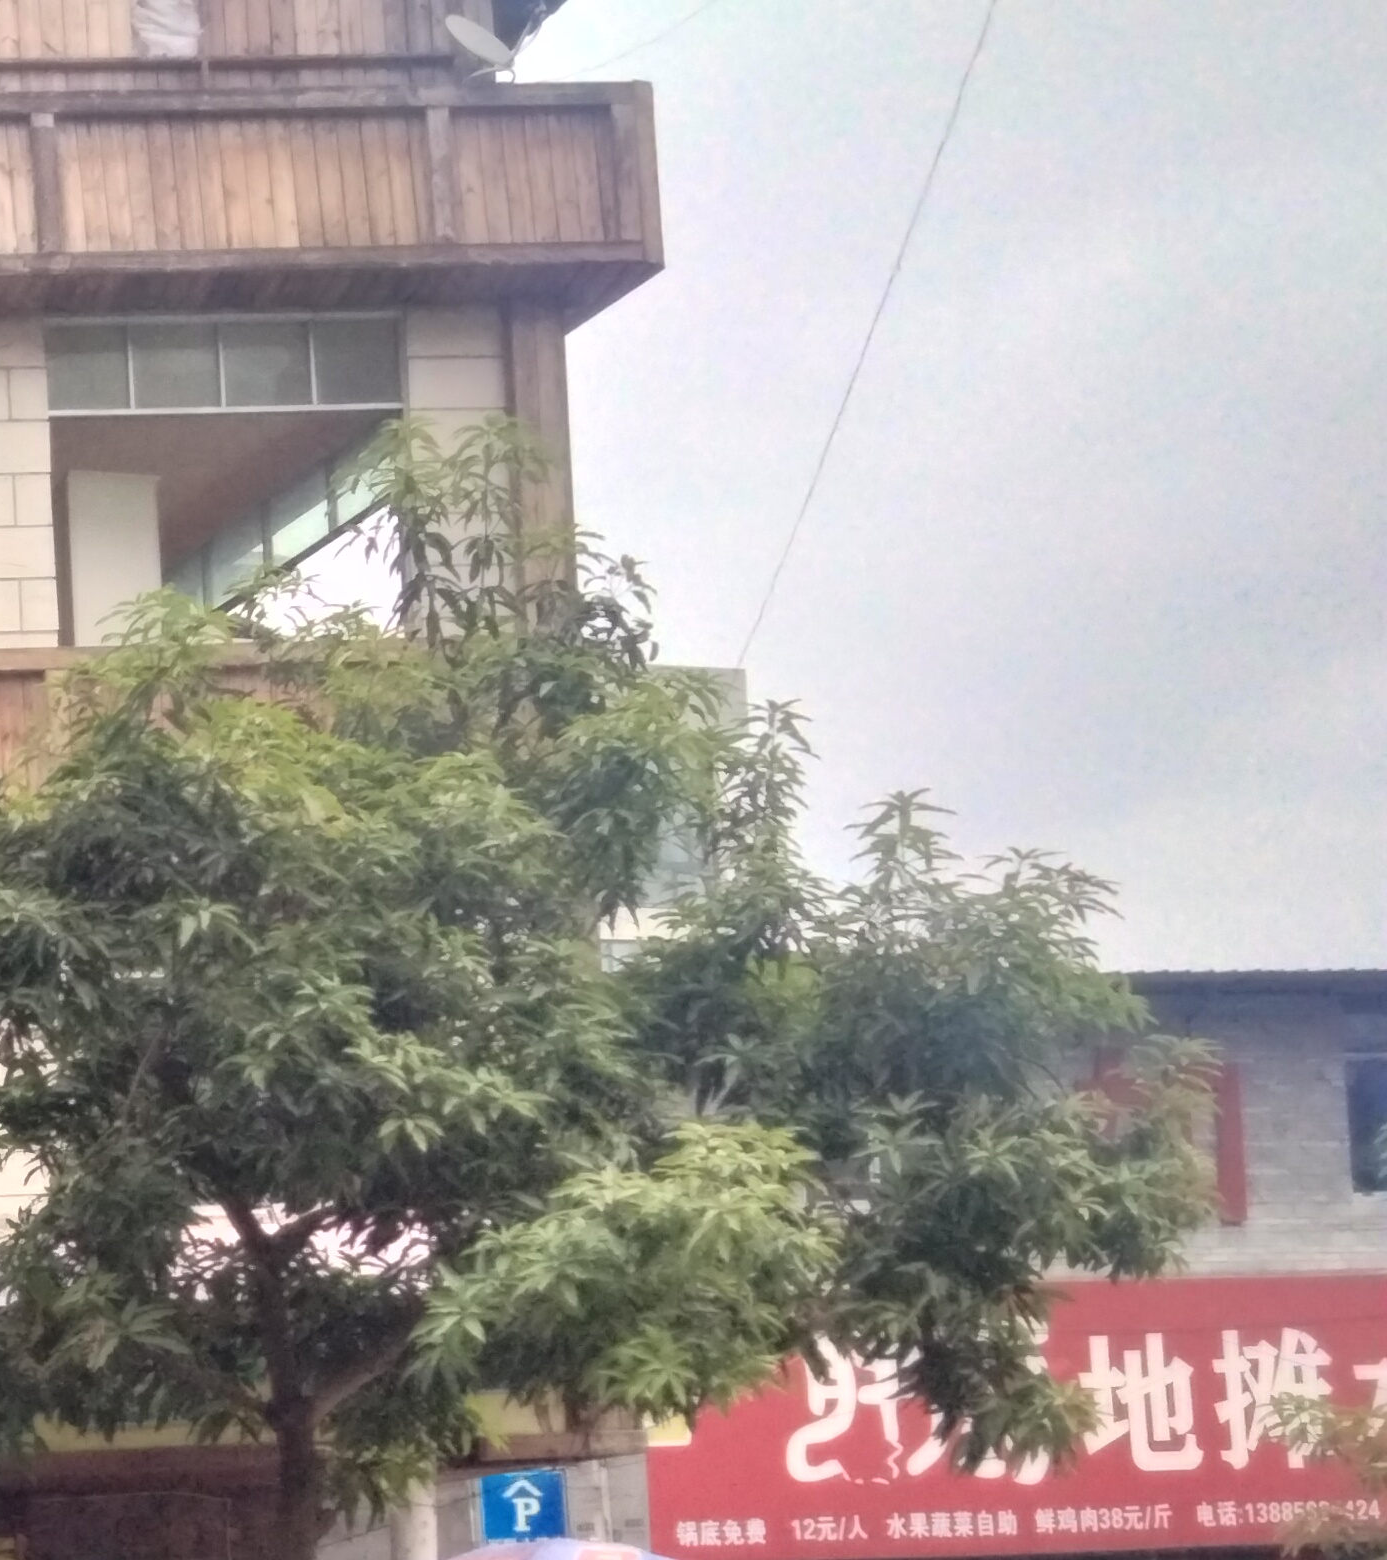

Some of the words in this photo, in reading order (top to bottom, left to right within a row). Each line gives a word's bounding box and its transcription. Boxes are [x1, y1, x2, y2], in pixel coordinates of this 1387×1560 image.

[513, 1495, 541, 1532] P
[676, 1518, 767, 1547] 锅底免费
[791, 1514, 868, 1541] 12元/人
[886, 1509, 1018, 1539] 水果蔬菜自助
[1035, 1503, 1173, 1534] 鲜鸡肉38元/斤
[1196, 1499, 1381, 1528] 电话:13885424
